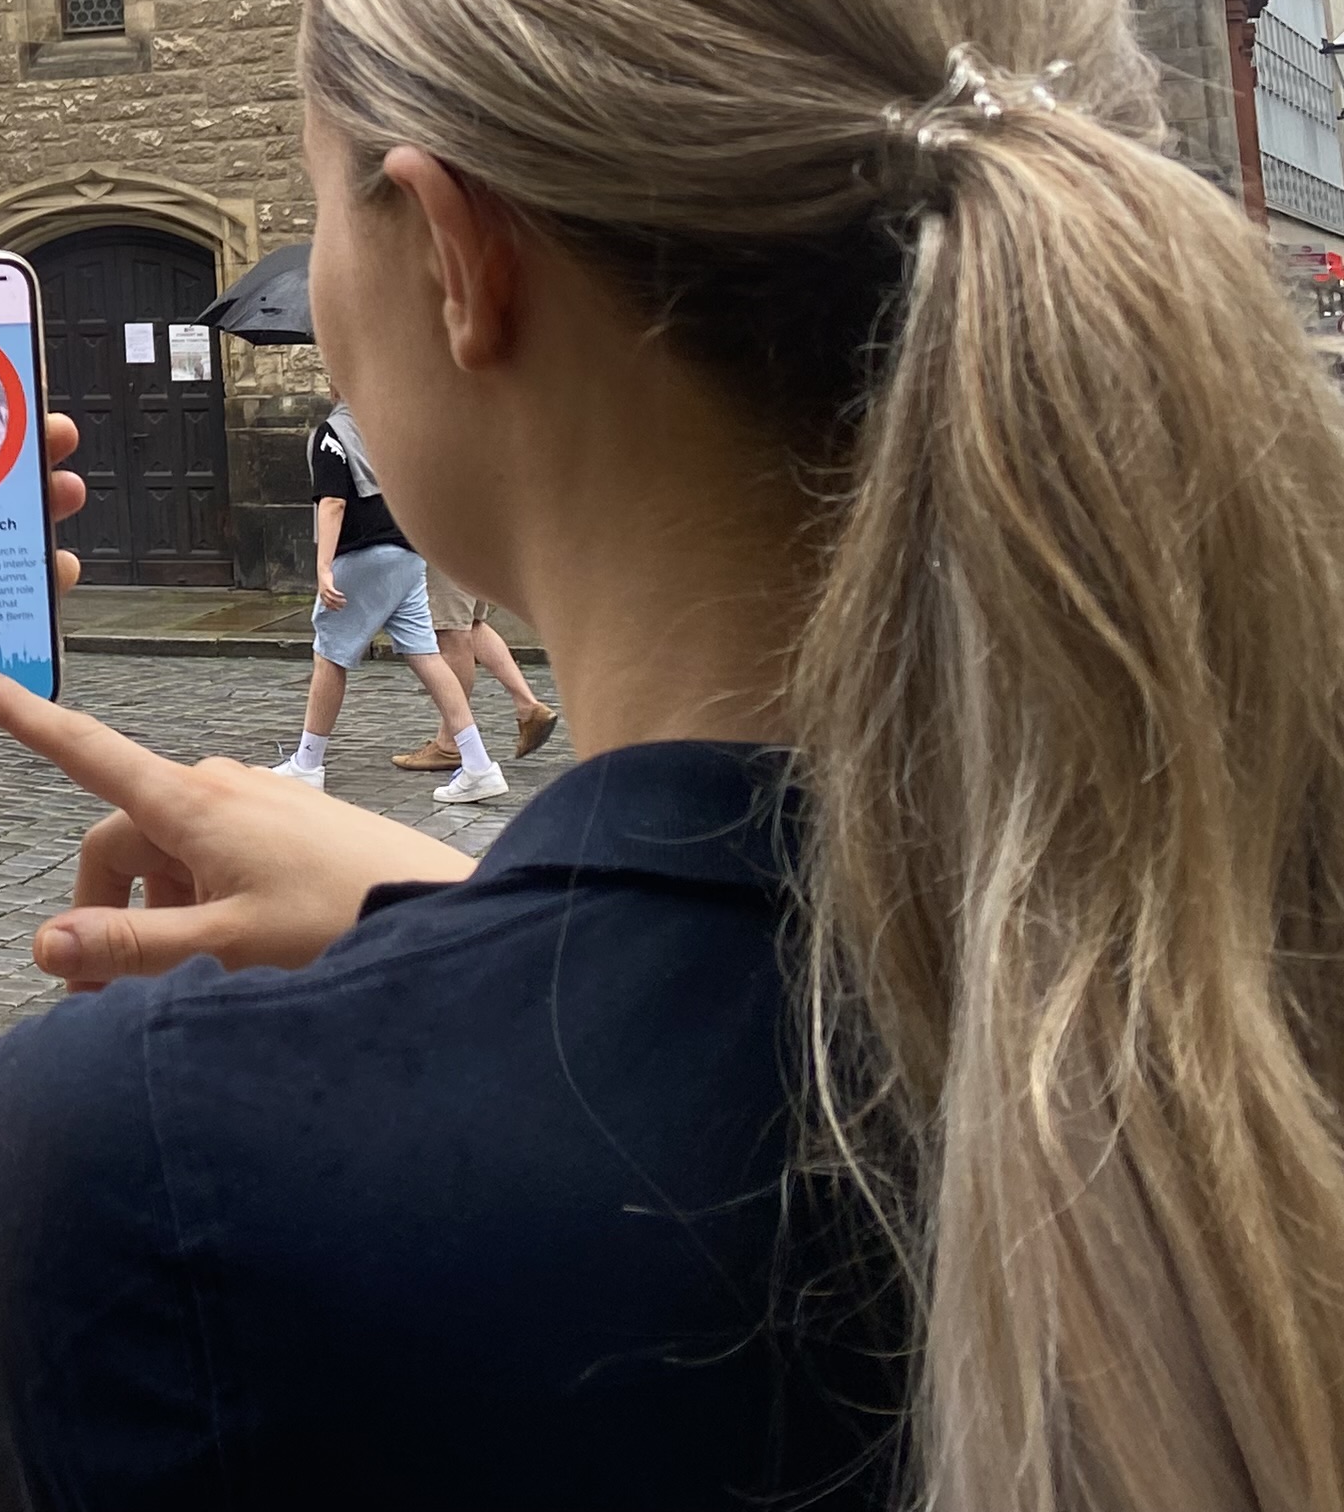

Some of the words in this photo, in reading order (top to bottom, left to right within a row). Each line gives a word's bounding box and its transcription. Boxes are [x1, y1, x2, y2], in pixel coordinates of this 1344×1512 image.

[18, 546, 27, 554] in
[16, 585, 34, 594] role
[0, 599, 17, 608] that
